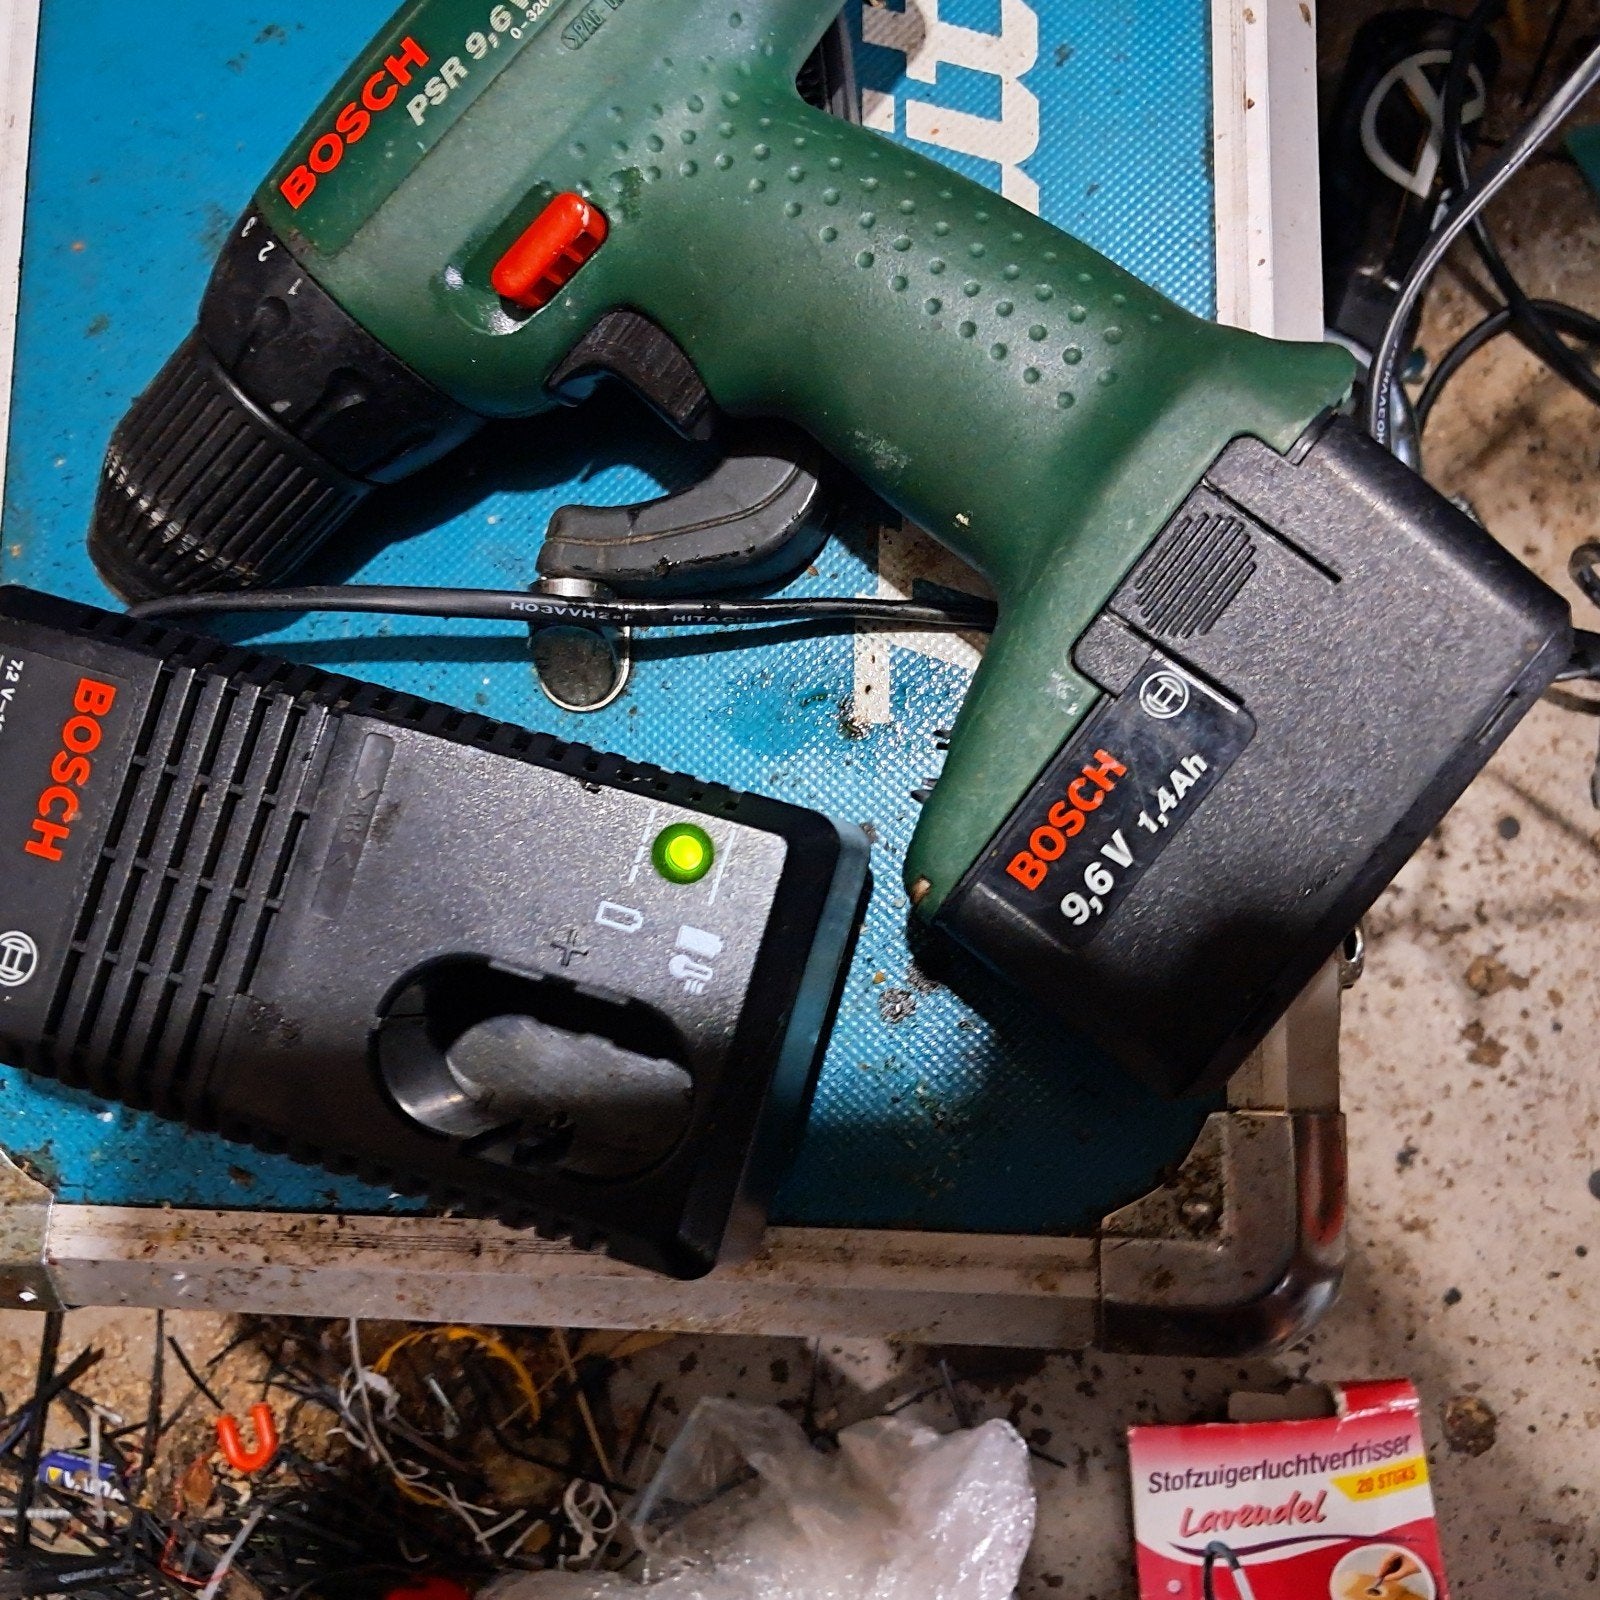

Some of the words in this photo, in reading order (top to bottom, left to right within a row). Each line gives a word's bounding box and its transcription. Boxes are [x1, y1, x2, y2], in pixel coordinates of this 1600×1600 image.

[280, 37, 429, 209] BOSCH
[406, 56, 468, 126] PSR
[465, 5, 513, 60] 9,6
[258, 241, 275, 262] 2
[5, 659, 25, 682] 7,2
[25, 678, 117, 861] BOSCH
[1005, 748, 1128, 891] BOSCH
[1060, 861, 1114, 926] 9,6
[1100, 829, 1134, 869] V
[1137, 754, 1208, 834] 1,4Ah
[1148, 1432, 1412, 1494] Stofzuigerluchtverfrisser
[1179, 1490, 1328, 1538] Lavendel
